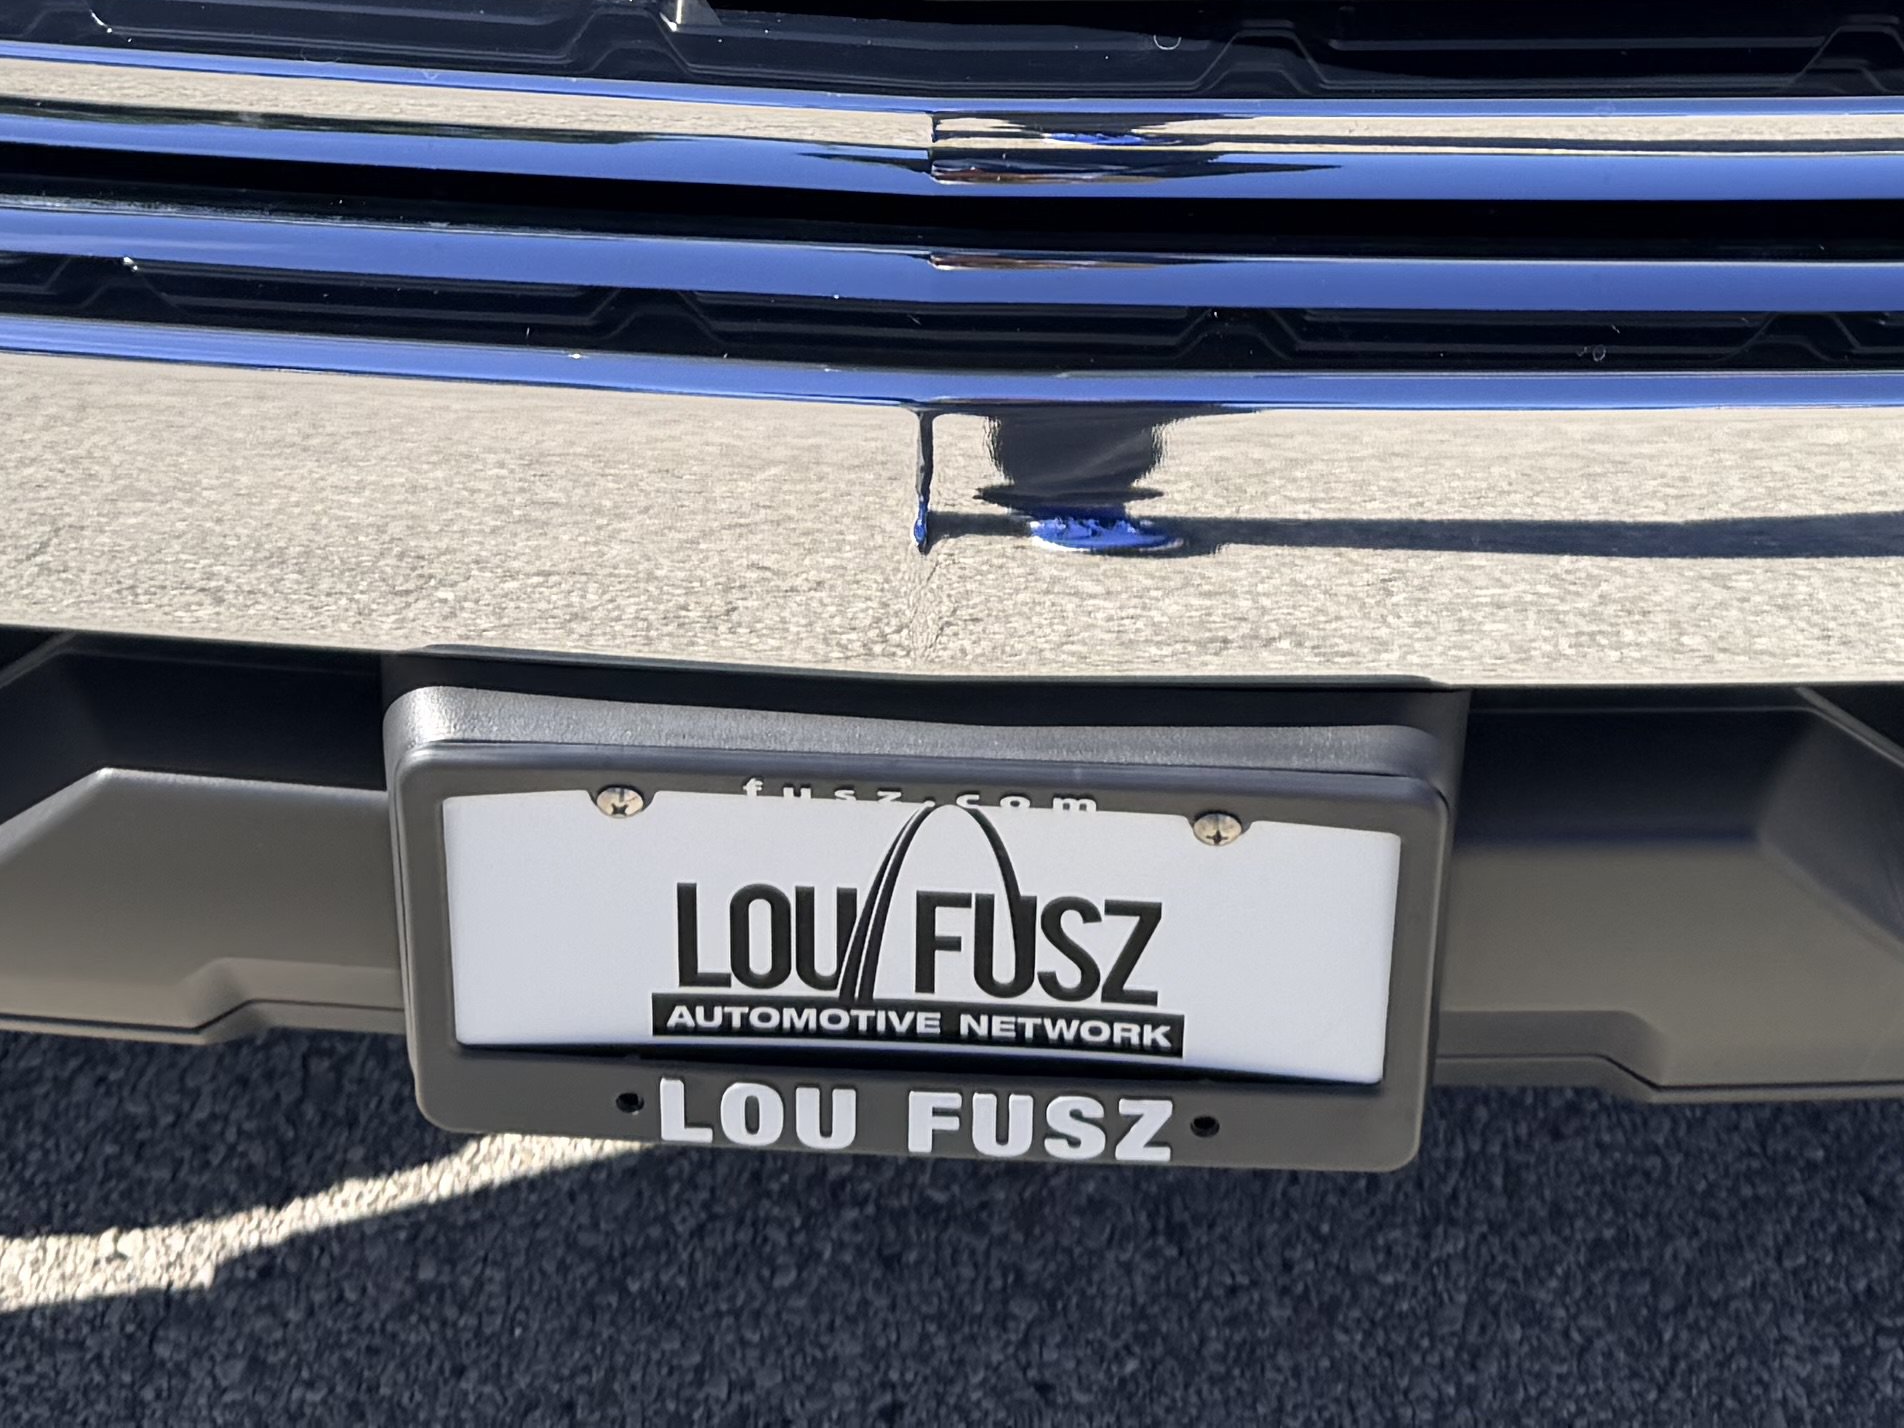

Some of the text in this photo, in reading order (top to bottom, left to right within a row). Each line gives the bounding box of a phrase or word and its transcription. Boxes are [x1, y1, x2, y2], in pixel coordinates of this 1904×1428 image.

[676, 881, 1163, 1006] LOU FUSZ
[666, 1004, 1172, 1048] AUTOMOTIVE NETWORK
[659, 1076, 1174, 1162] LOU FUSZ
